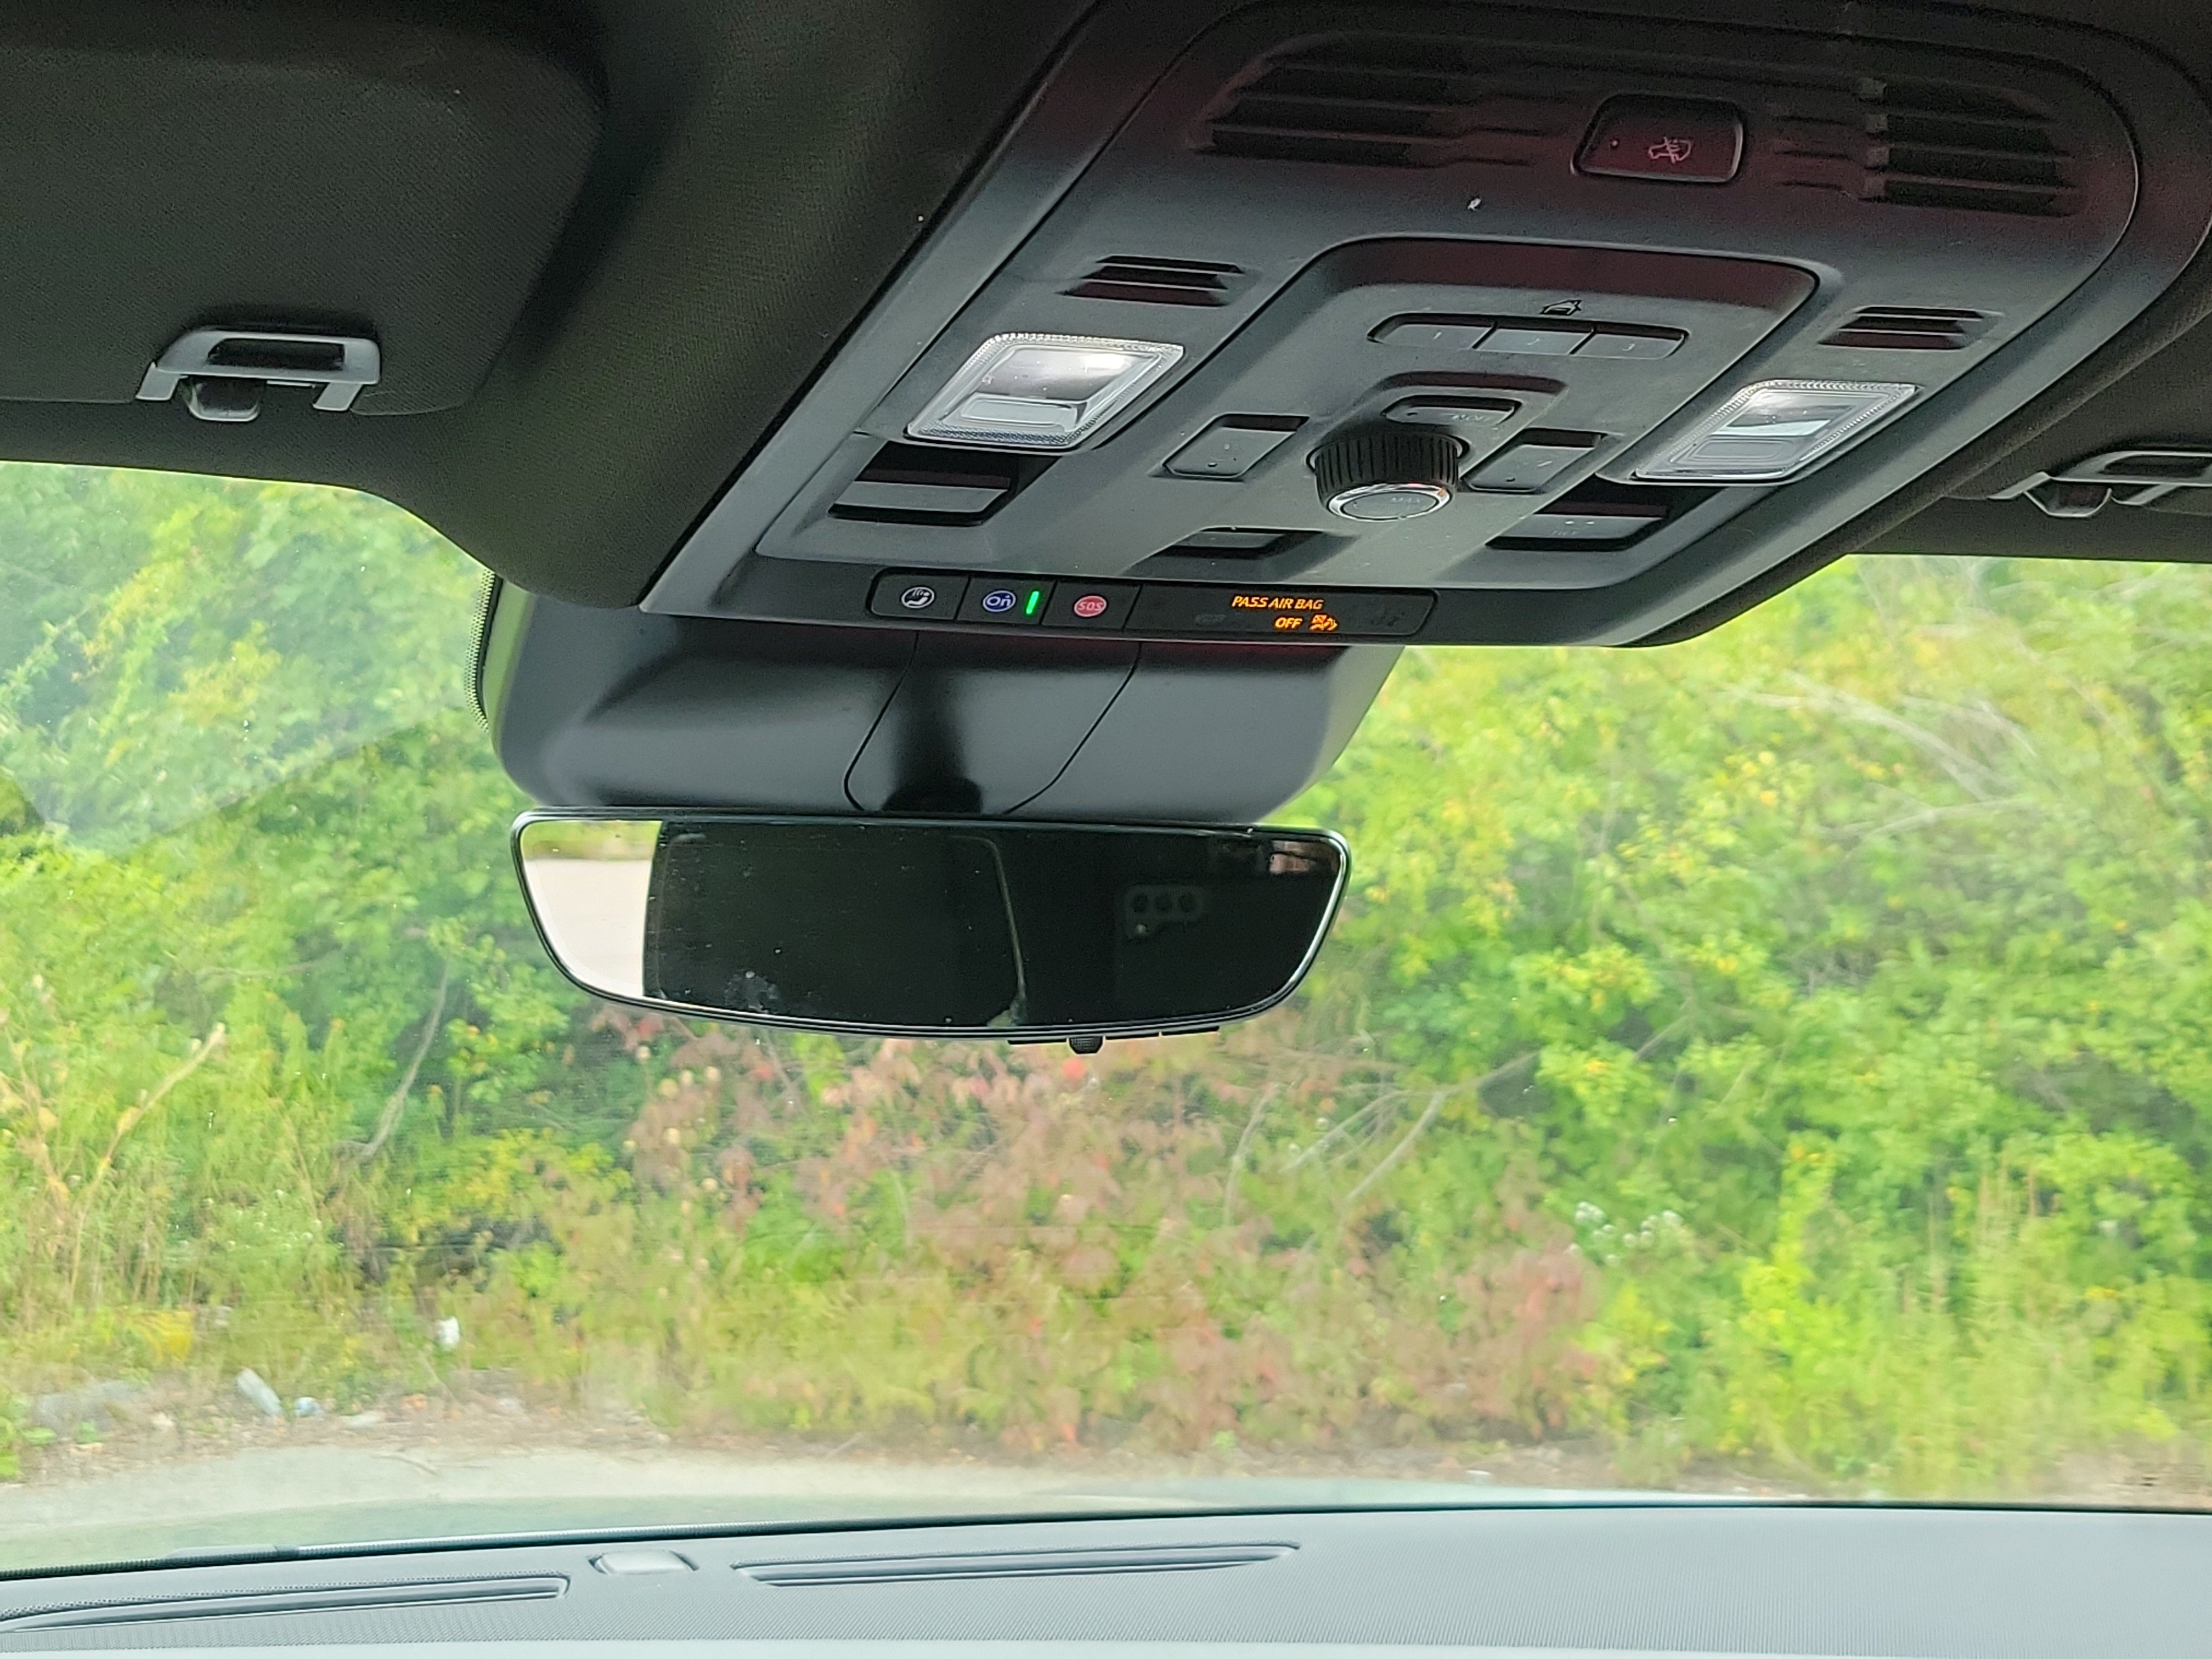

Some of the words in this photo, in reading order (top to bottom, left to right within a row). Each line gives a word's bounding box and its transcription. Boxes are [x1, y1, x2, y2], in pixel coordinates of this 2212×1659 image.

[1077, 601, 1103, 611] SOS
[1232, 595, 1269, 607] PASS
[1268, 597, 1294, 609] AIR
[1294, 599, 1324, 610] BAG
[1275, 617, 1303, 629] OFF
